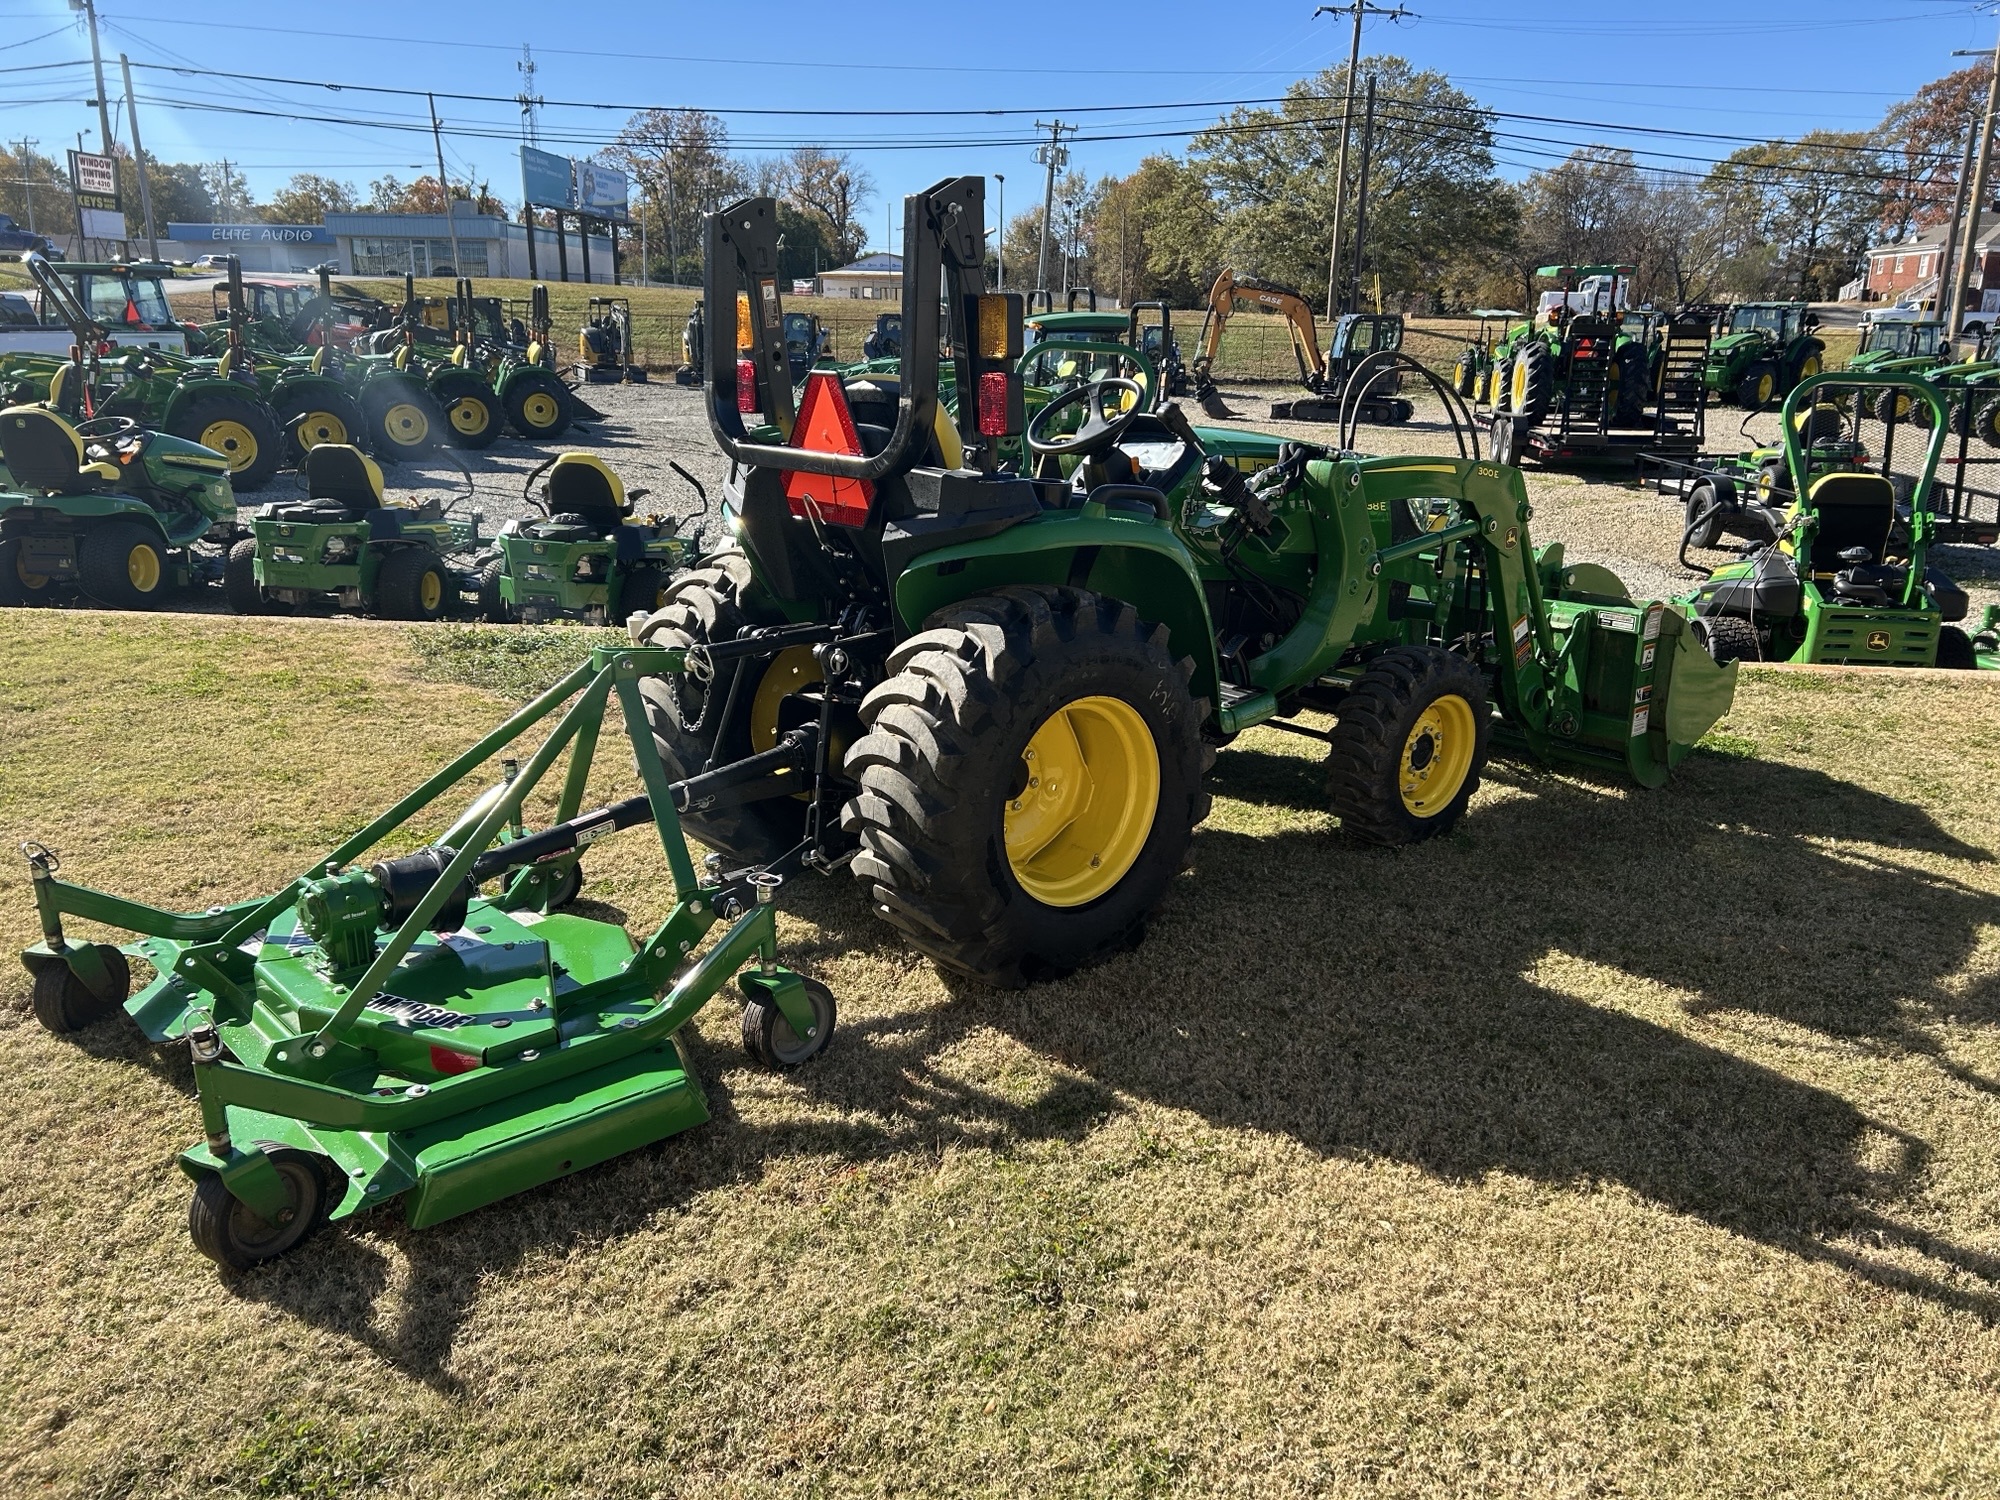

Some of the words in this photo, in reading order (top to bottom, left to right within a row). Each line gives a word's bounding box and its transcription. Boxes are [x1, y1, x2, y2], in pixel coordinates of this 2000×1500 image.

[79, 157, 111, 170] WINDOW
[82, 168, 111, 180] TINTING
[77, 195, 104, 208] KEYS
[212, 228, 251, 240] ELITE
[261, 229, 313, 241] AUDIO
[1259, 294, 1283, 306] CASE
[1478, 466, 1499, 479] 300E
